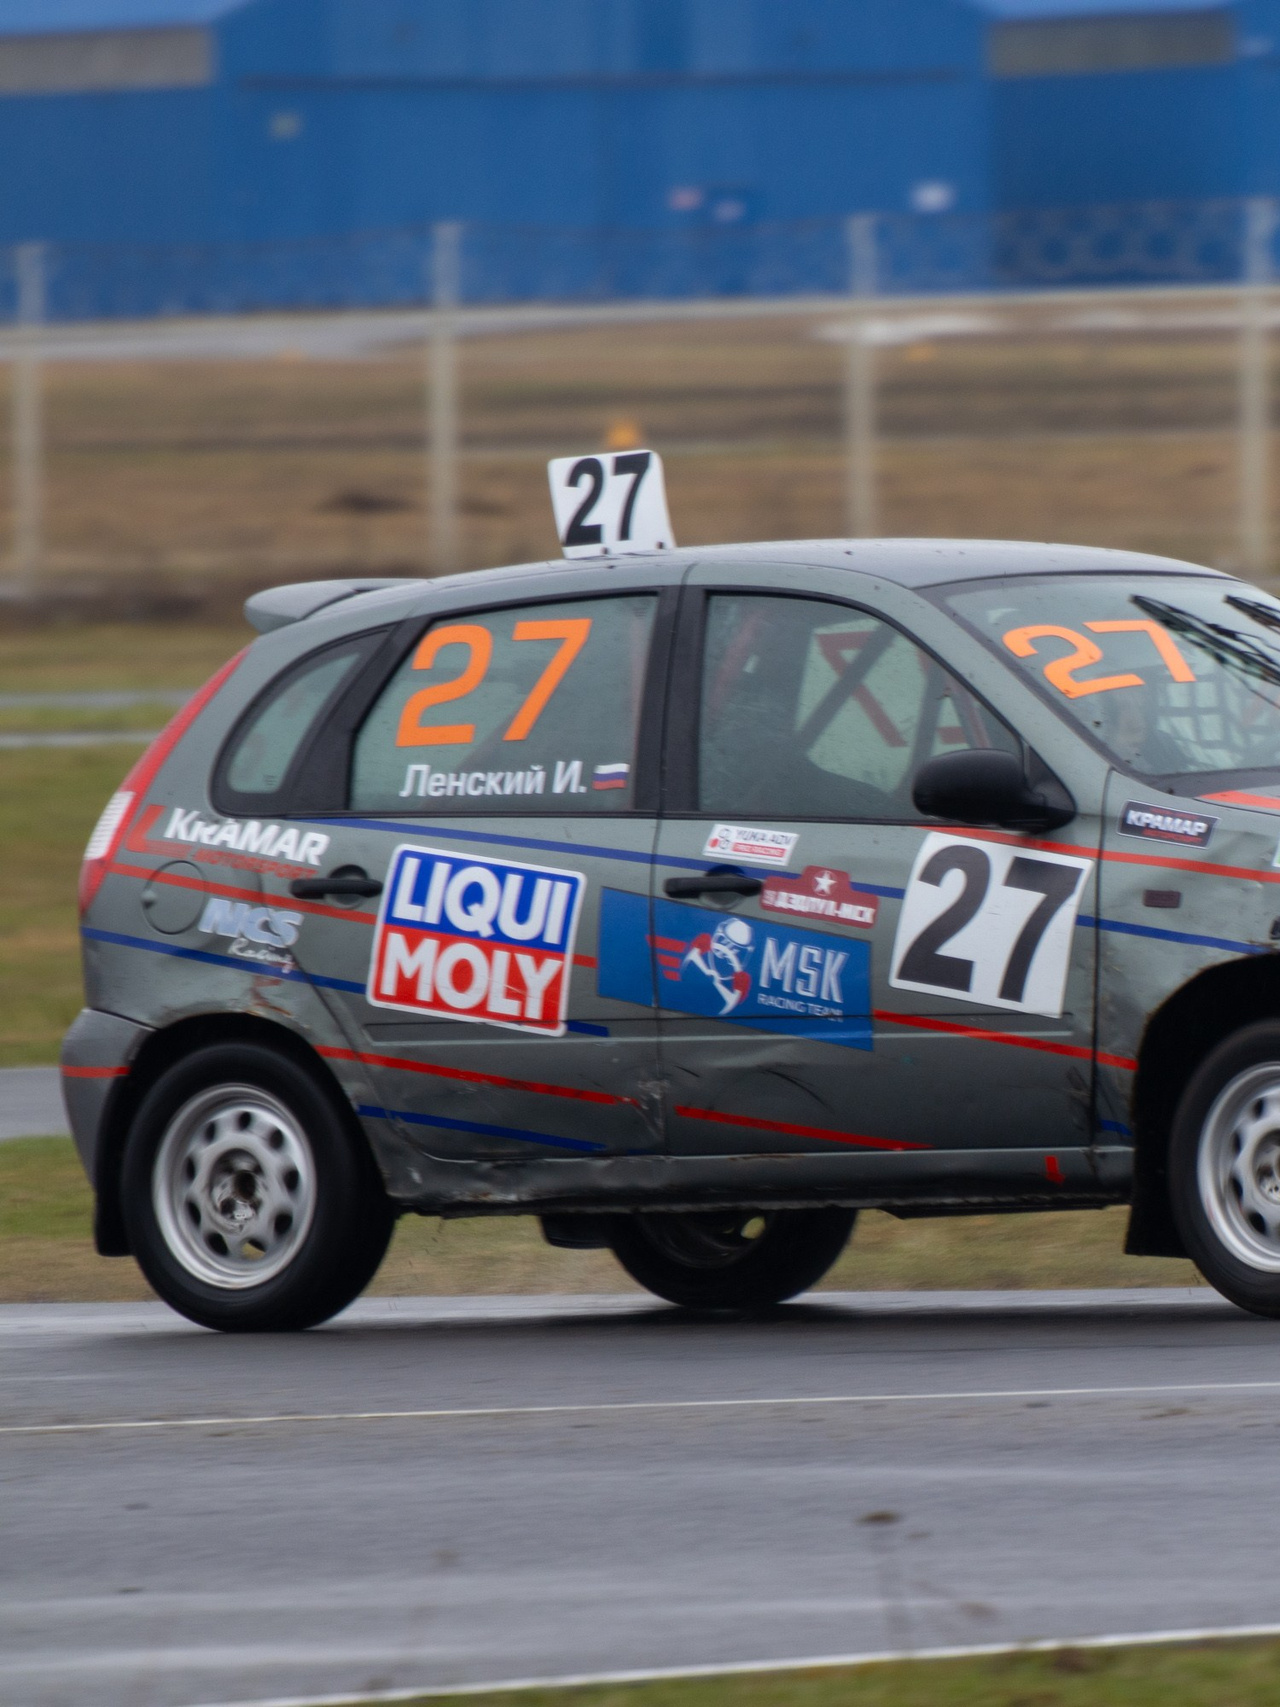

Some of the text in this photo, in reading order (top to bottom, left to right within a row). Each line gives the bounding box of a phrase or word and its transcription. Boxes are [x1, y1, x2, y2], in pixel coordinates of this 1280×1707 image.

[564, 452, 651, 547] 27
[395, 618, 592, 747] 27
[1002, 619, 1197, 699] 27
[399, 760, 588, 797] Ленский И.
[391, 856, 573, 945] LIQUI
[896, 844, 1084, 1003] 27
[380, 931, 564, 1020] MOLY
[757, 993, 807, 1013] RACING
[759, 937, 850, 1004] MSK
